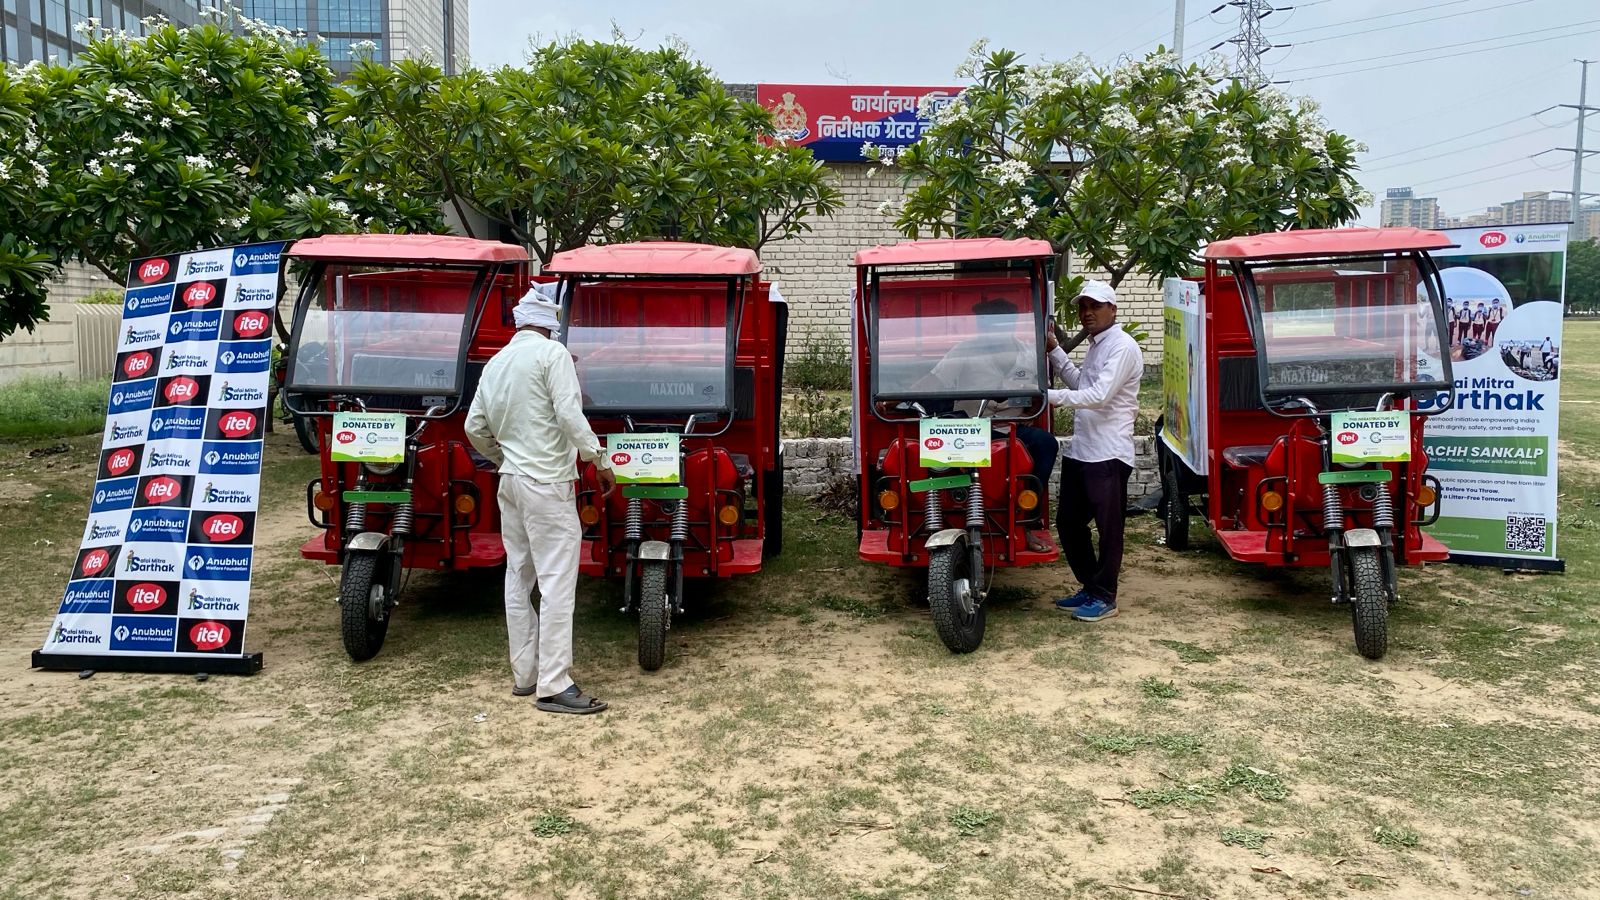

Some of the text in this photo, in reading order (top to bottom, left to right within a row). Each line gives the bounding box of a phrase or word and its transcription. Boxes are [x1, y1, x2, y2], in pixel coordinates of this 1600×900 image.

[851, 90, 916, 113] कार्यालय
[817, 115, 882, 139] निरीक्षक
[884, 117, 917, 139] ग्रेटर
[1485, 236, 1502, 244] itel
[249, 253, 279, 261] Anubhu
[143, 263, 164, 277] itel
[190, 262, 225, 275] Sarthak
[140, 293, 171, 305] Anubhuti
[188, 287, 210, 301] itel
[184, 319, 218, 328] Anubhuti
[240, 317, 264, 330] itel
[130, 331, 161, 344] Sarthak
[128, 356, 148, 371] itel
[1281, 369, 1329, 384] MAXTON
[1472, 377, 1514, 389] Mitra
[125, 388, 153, 399] Anubhuti
[170, 383, 193, 397] itel
[225, 387, 263, 401] Sarthak
[650, 383, 694, 395] MAXTON
[165, 418, 202, 426] Anubhuti
[226, 417, 251, 430] itel
[384, 422, 395, 430] BY
[114, 427, 143, 440] Sarthak
[222, 452, 259, 460] Anubhuti
[1424, 446, 1544, 458] ACHH SANKALP
[112, 454, 130, 468] itel
[106, 487, 134, 497] Anubhuti
[149, 482, 172, 497] itel
[210, 489, 251, 503] Sarthak
[143, 519, 185, 527] Anubhuti
[210, 520, 237, 534] itel
[91, 527, 121, 540] Sarthak
[86, 551, 105, 565] itel
[131, 557, 175, 572] Sarthak
[206, 558, 248, 566] Anubhuti
[73, 590, 110, 599] Anubhuti
[134, 590, 160, 604] itel
[194, 595, 240, 611] Sarthak
[58, 628, 101, 644] Sarthak
[132, 628, 173, 636] Anubhuti
[197, 628, 223, 643] itel
